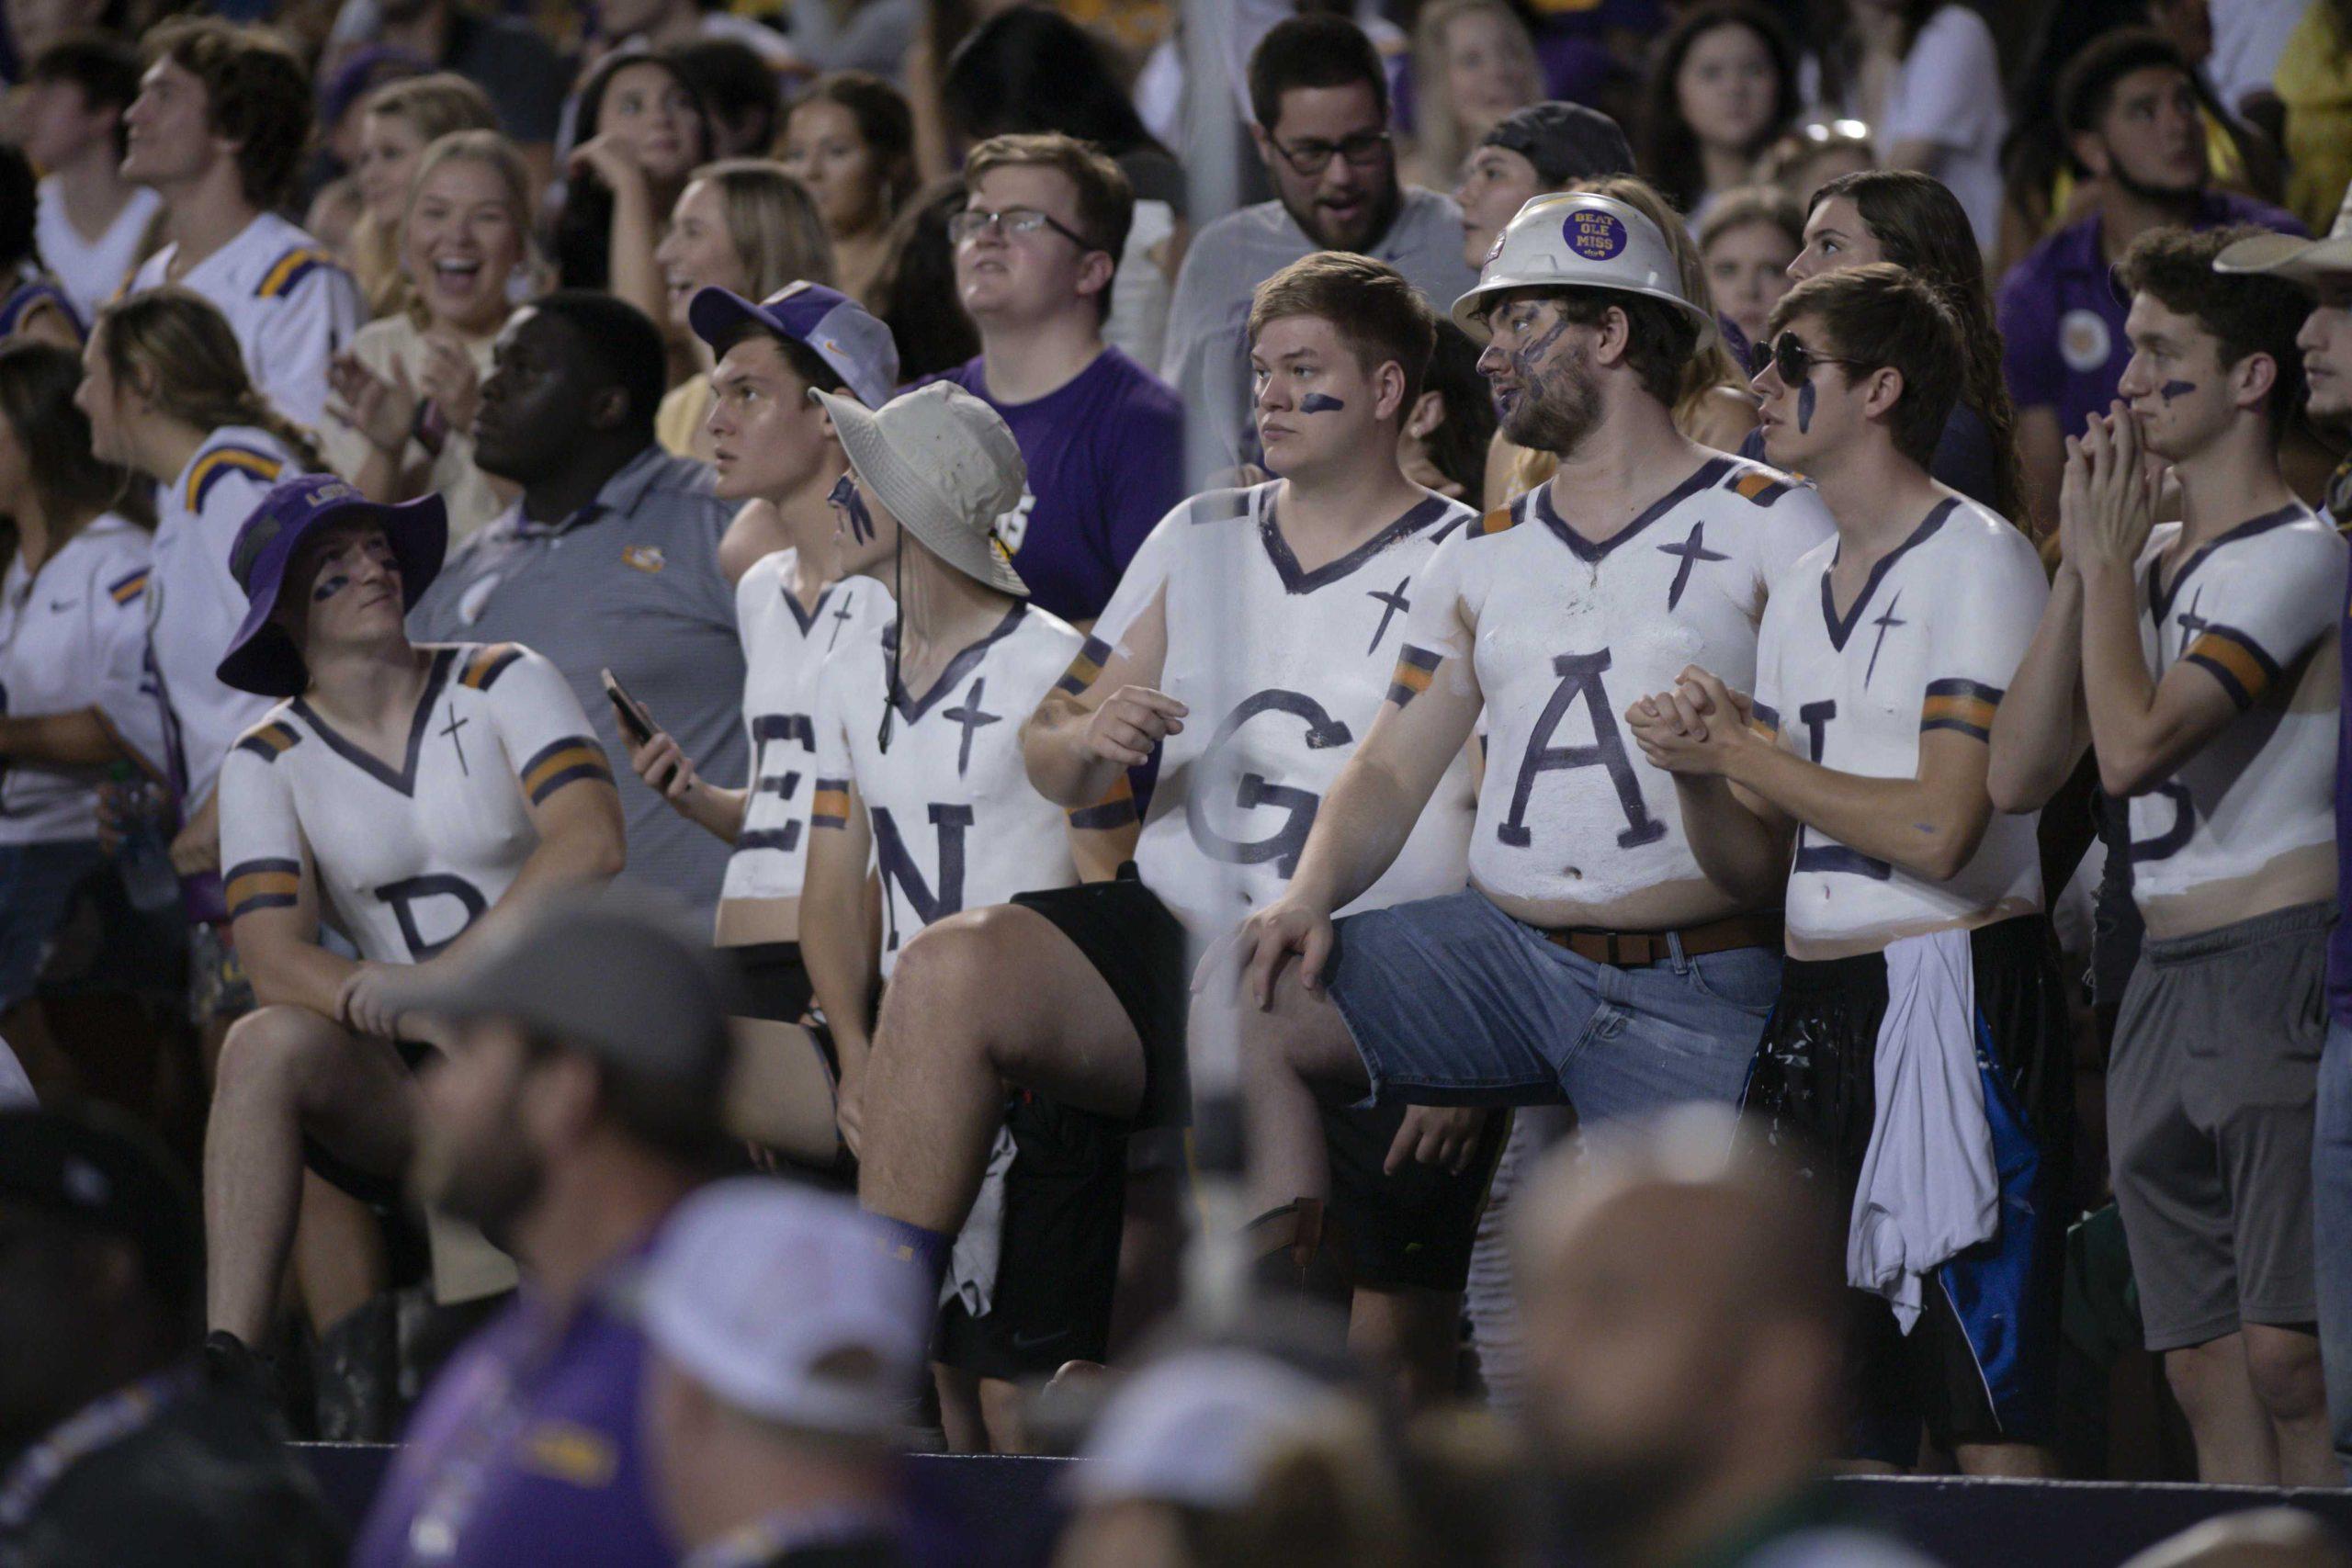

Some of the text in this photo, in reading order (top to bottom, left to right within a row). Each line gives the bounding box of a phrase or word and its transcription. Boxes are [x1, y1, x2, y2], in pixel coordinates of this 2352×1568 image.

[1575, 213, 1614, 226] BEAT
[1576, 235, 1613, 250] MISS
[1580, 223, 1610, 236] OLE
[1186, 689, 1353, 880] G
[1498, 647, 1668, 849] A
[871, 803, 975, 952] N
